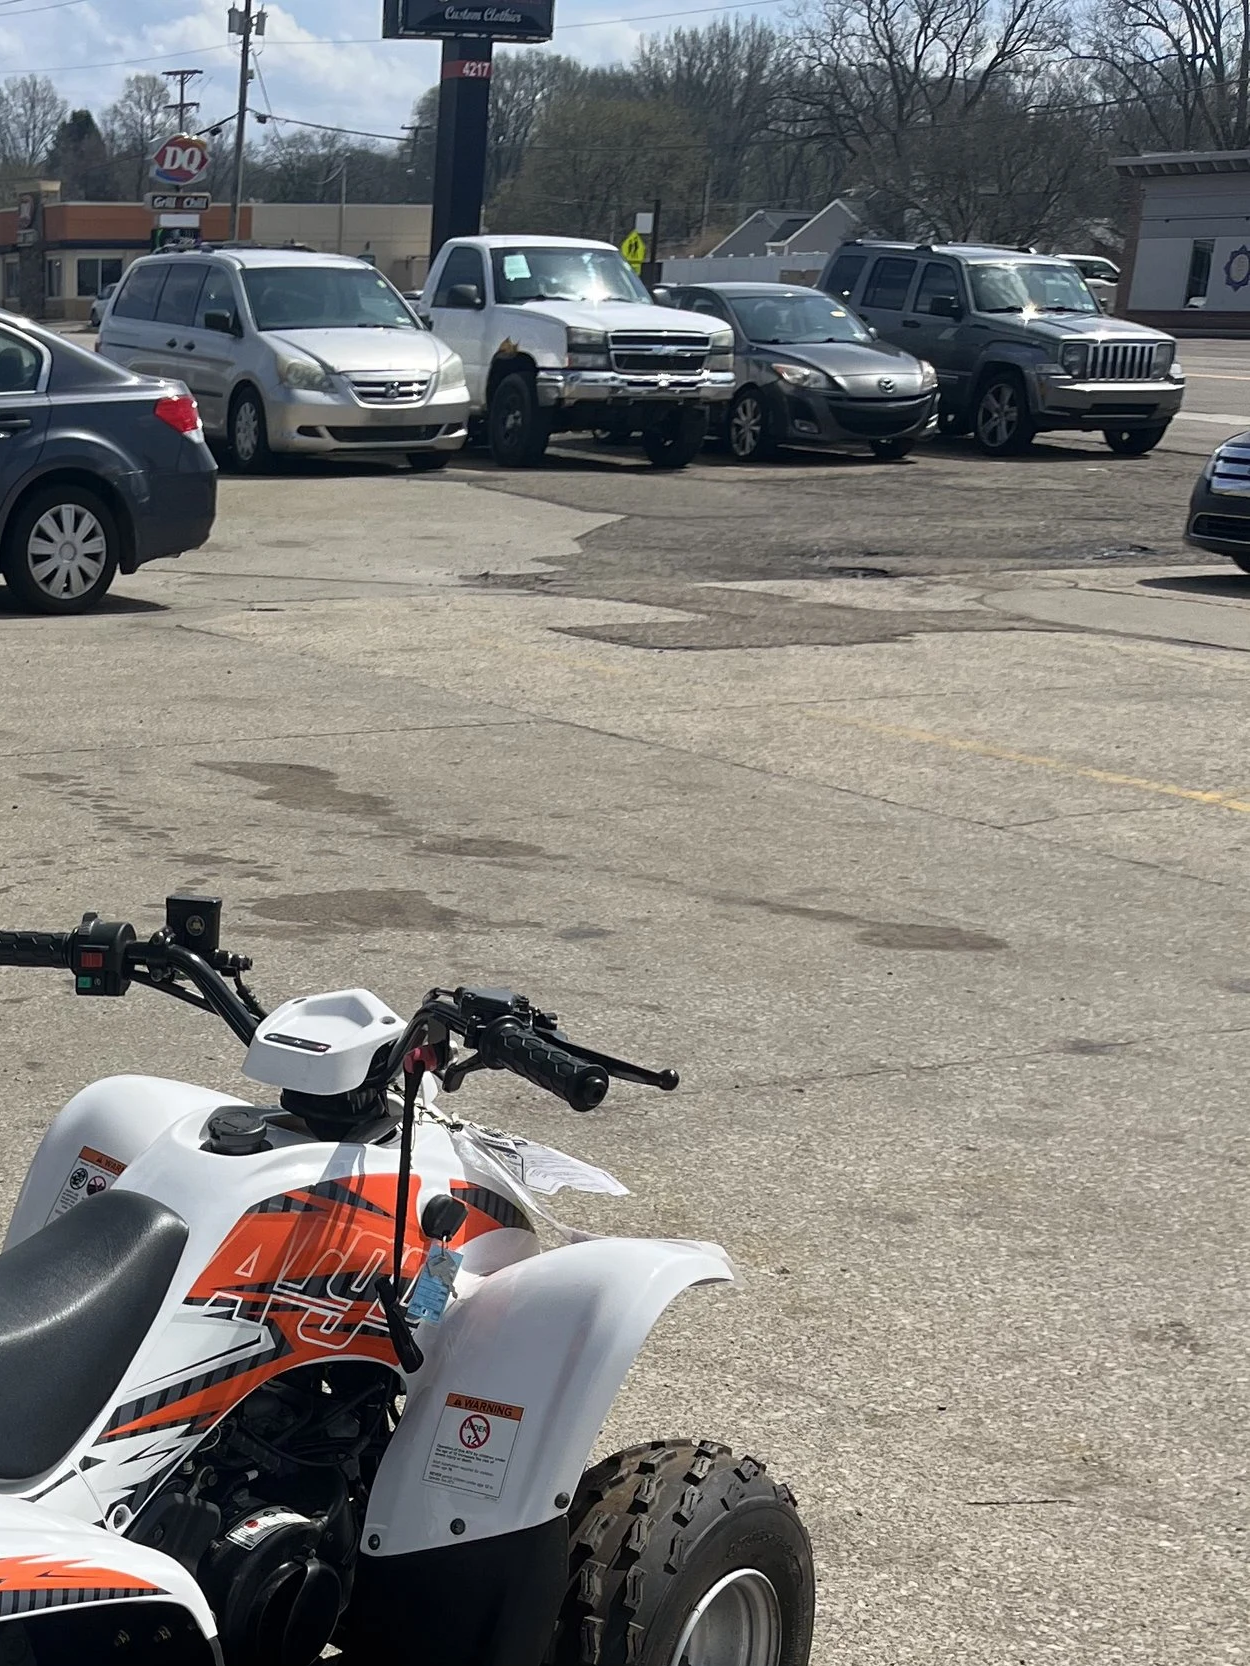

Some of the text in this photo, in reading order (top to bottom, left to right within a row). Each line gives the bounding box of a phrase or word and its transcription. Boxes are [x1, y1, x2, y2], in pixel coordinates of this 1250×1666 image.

[445, 6, 522, 23] Custom Clothier
[462, 61, 491, 77] 4217
[162, 146, 202, 175] DQ
[153, 196, 208, 210] Grill Chill
[463, 1398, 513, 1417] WARNING
[467, 1435, 479, 1447] 12
